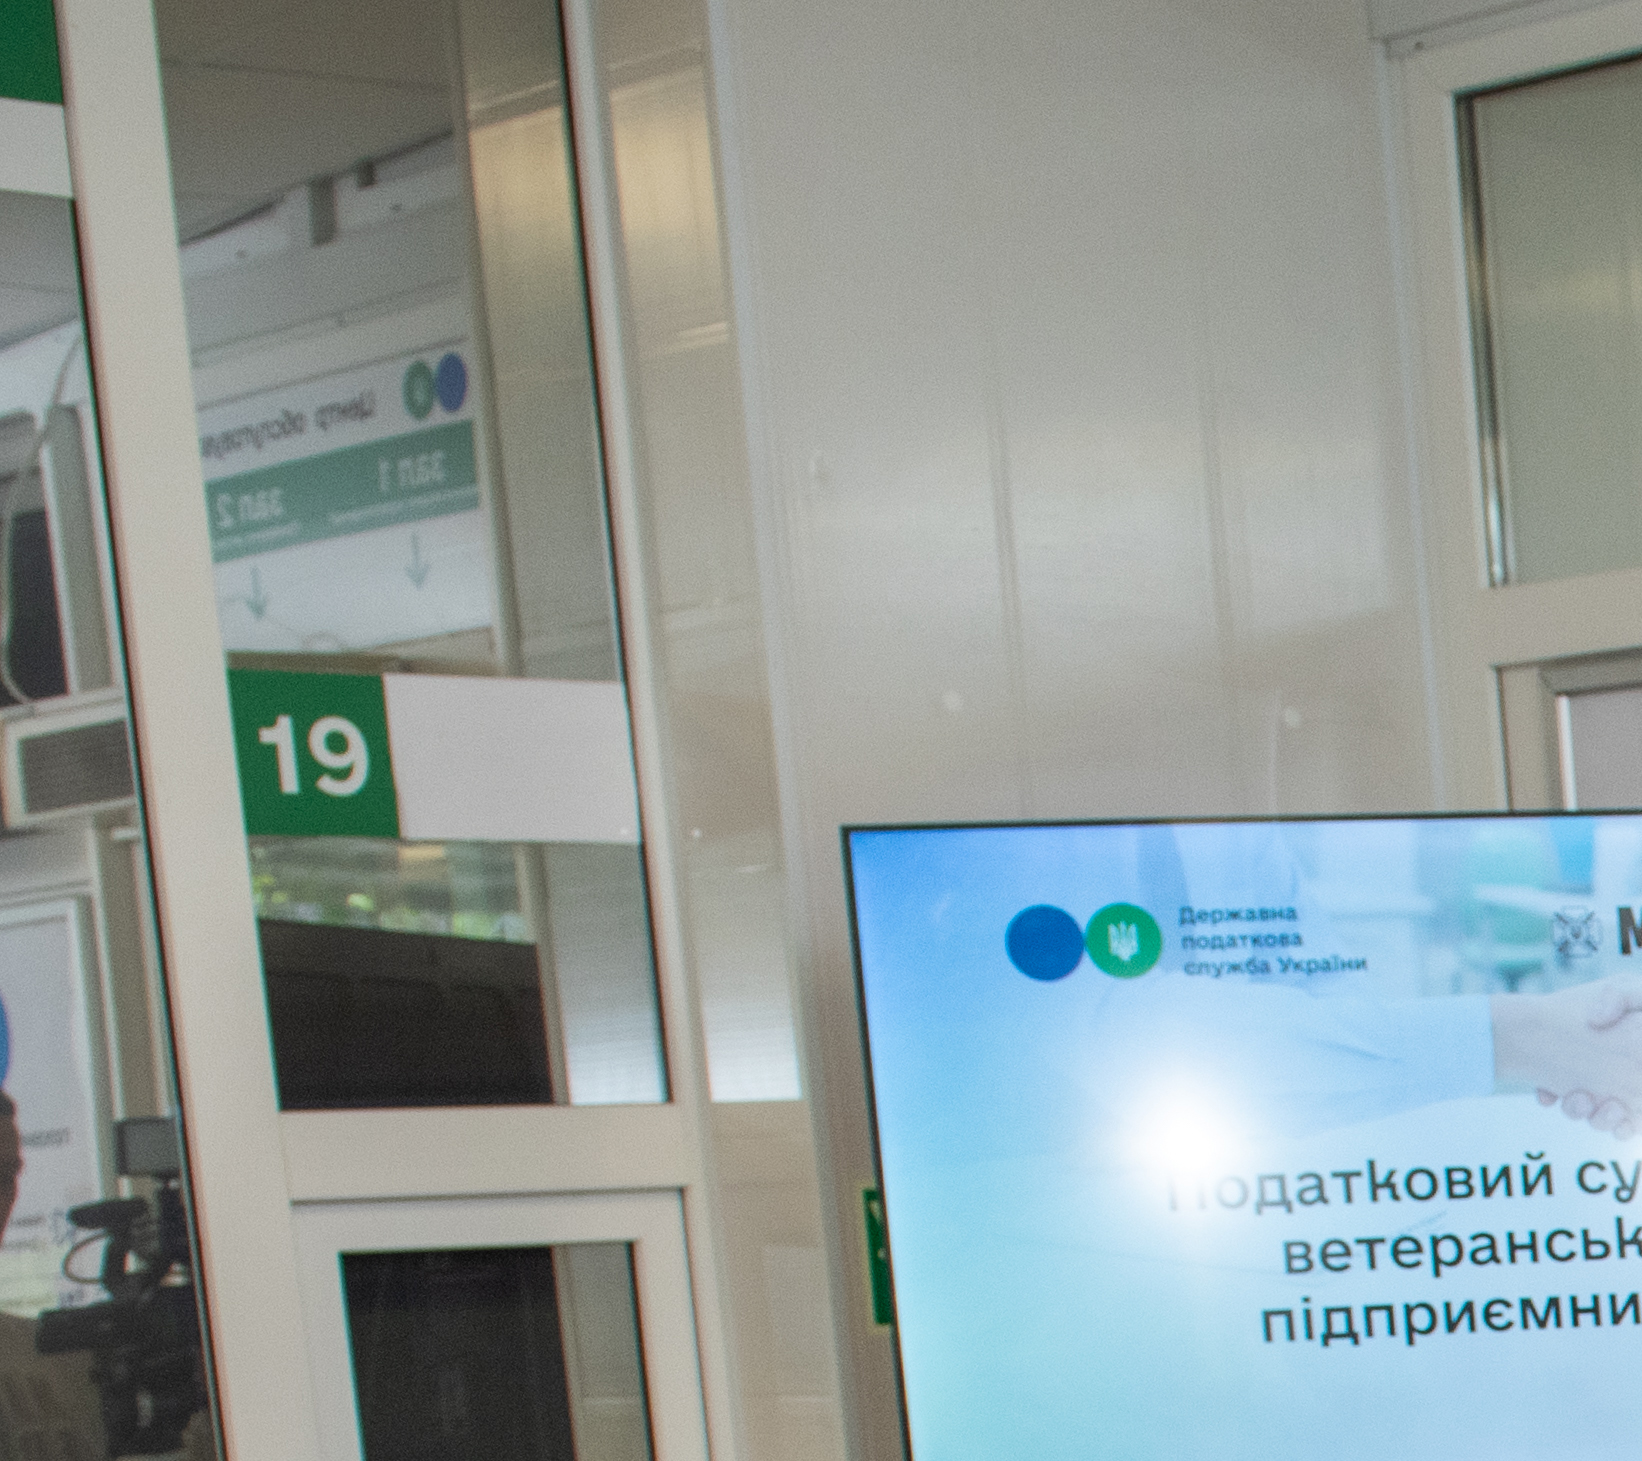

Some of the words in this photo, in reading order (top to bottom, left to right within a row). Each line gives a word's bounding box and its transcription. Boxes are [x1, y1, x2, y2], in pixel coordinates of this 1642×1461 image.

[259, 714, 370, 796] 19
[1176, 903, 1299, 929] Державна
[1179, 931, 1304, 952] податкова
[1181, 954, 1273, 979] служба
[1276, 954, 1368, 978] України
